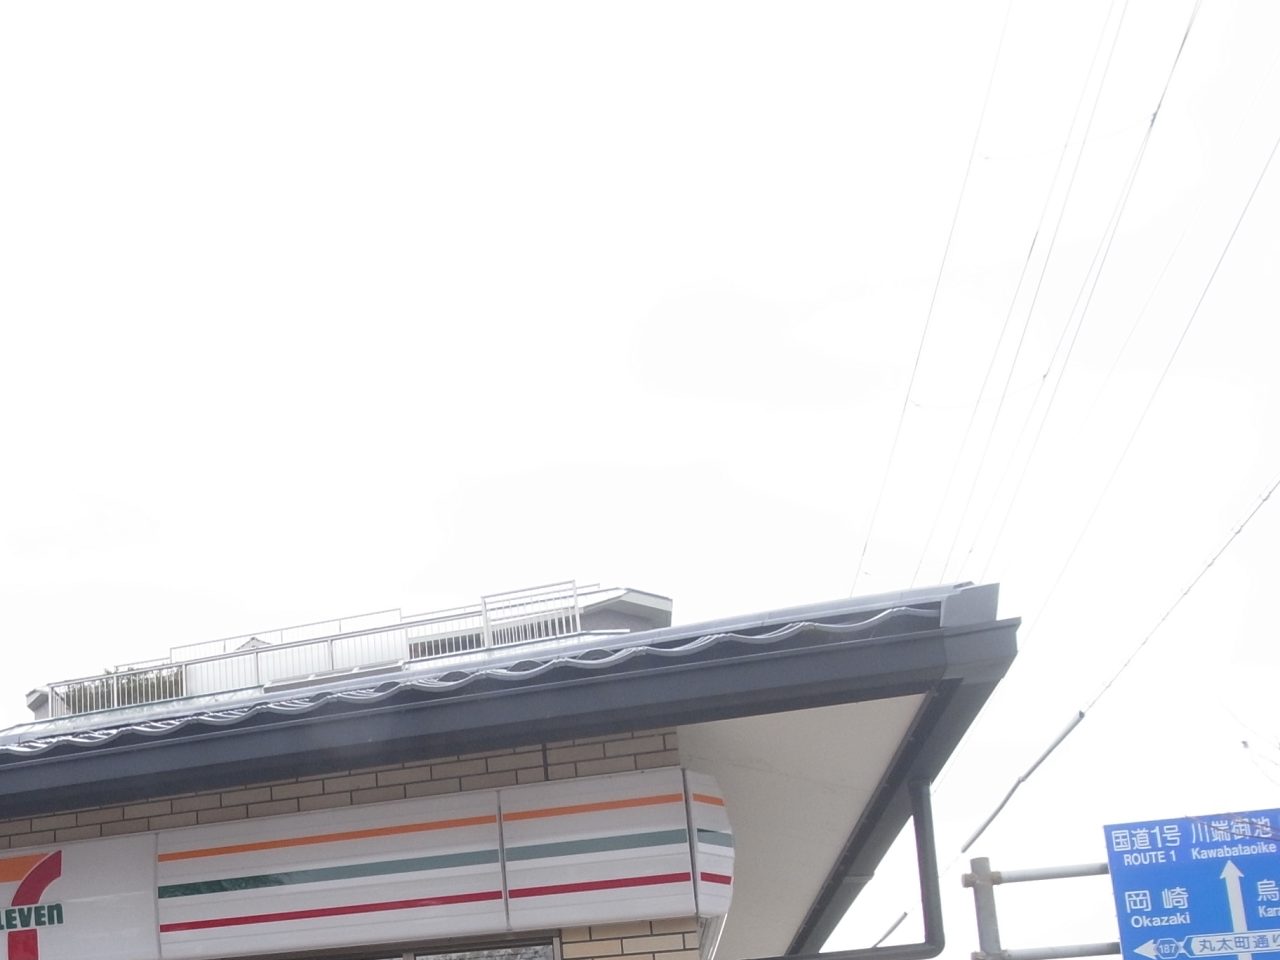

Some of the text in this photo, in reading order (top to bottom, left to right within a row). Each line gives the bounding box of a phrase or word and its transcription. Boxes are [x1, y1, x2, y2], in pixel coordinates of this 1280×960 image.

[1111, 824, 1182, 851] 国道1号
[1124, 842, 1277, 866] ROUTE 1 Kawabataoike
[1125, 887, 1189, 913] 岡崎
[1131, 912, 1191, 928] Okazaki
[1159, 943, 1176, 954] 187
